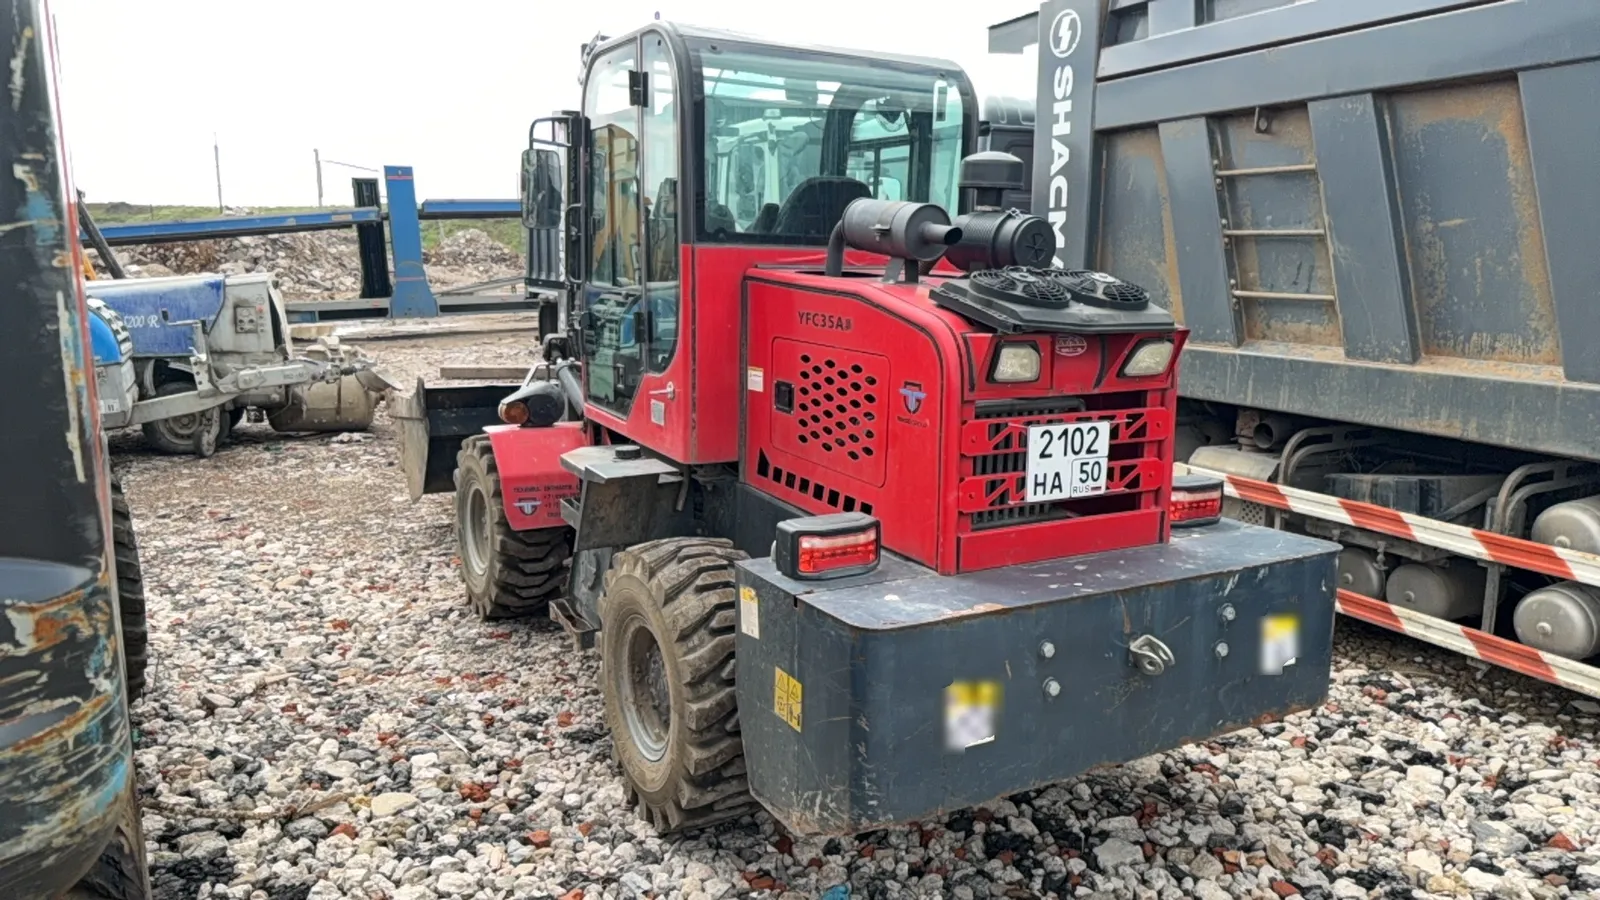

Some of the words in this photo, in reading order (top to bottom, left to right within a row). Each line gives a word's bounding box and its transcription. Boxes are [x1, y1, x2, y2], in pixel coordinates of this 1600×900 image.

[1048, 65, 1073, 270] SHACM
[1039, 426, 1099, 459] 2102
[1079, 461, 1102, 483] 50
[1072, 485, 1090, 494] RUS
